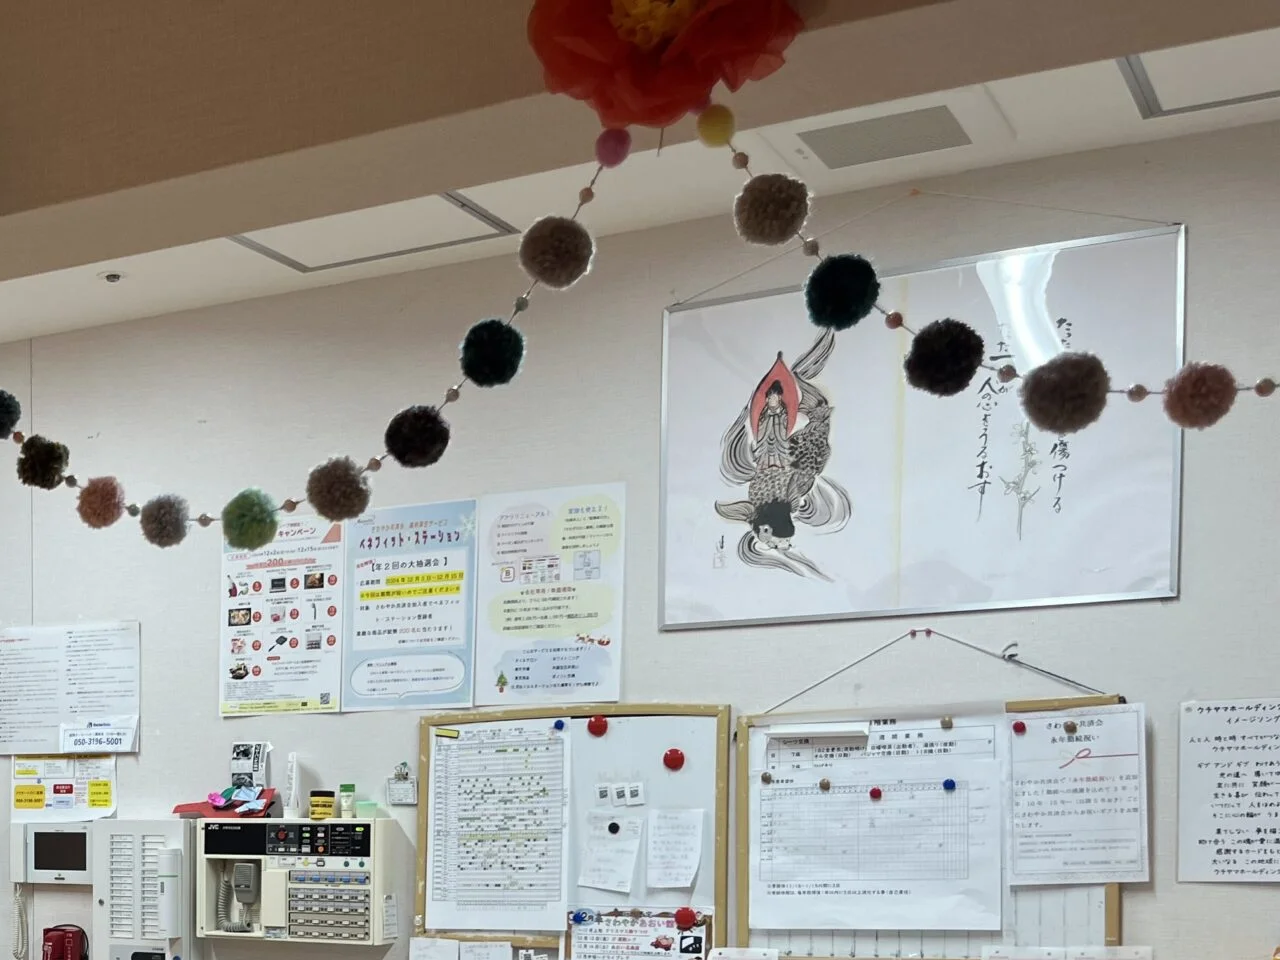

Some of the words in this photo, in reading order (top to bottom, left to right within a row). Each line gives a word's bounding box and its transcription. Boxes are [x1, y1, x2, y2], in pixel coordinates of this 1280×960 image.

[968, 377, 999, 523] 人の心をうるおす
[278, 527, 316, 538] キャンペーン
[1046, 720, 1104, 730] さわ共済会
[74, 738, 122, 746] 050-3196-5001
[1050, 735, 1100, 744] 永年勤続祝い
